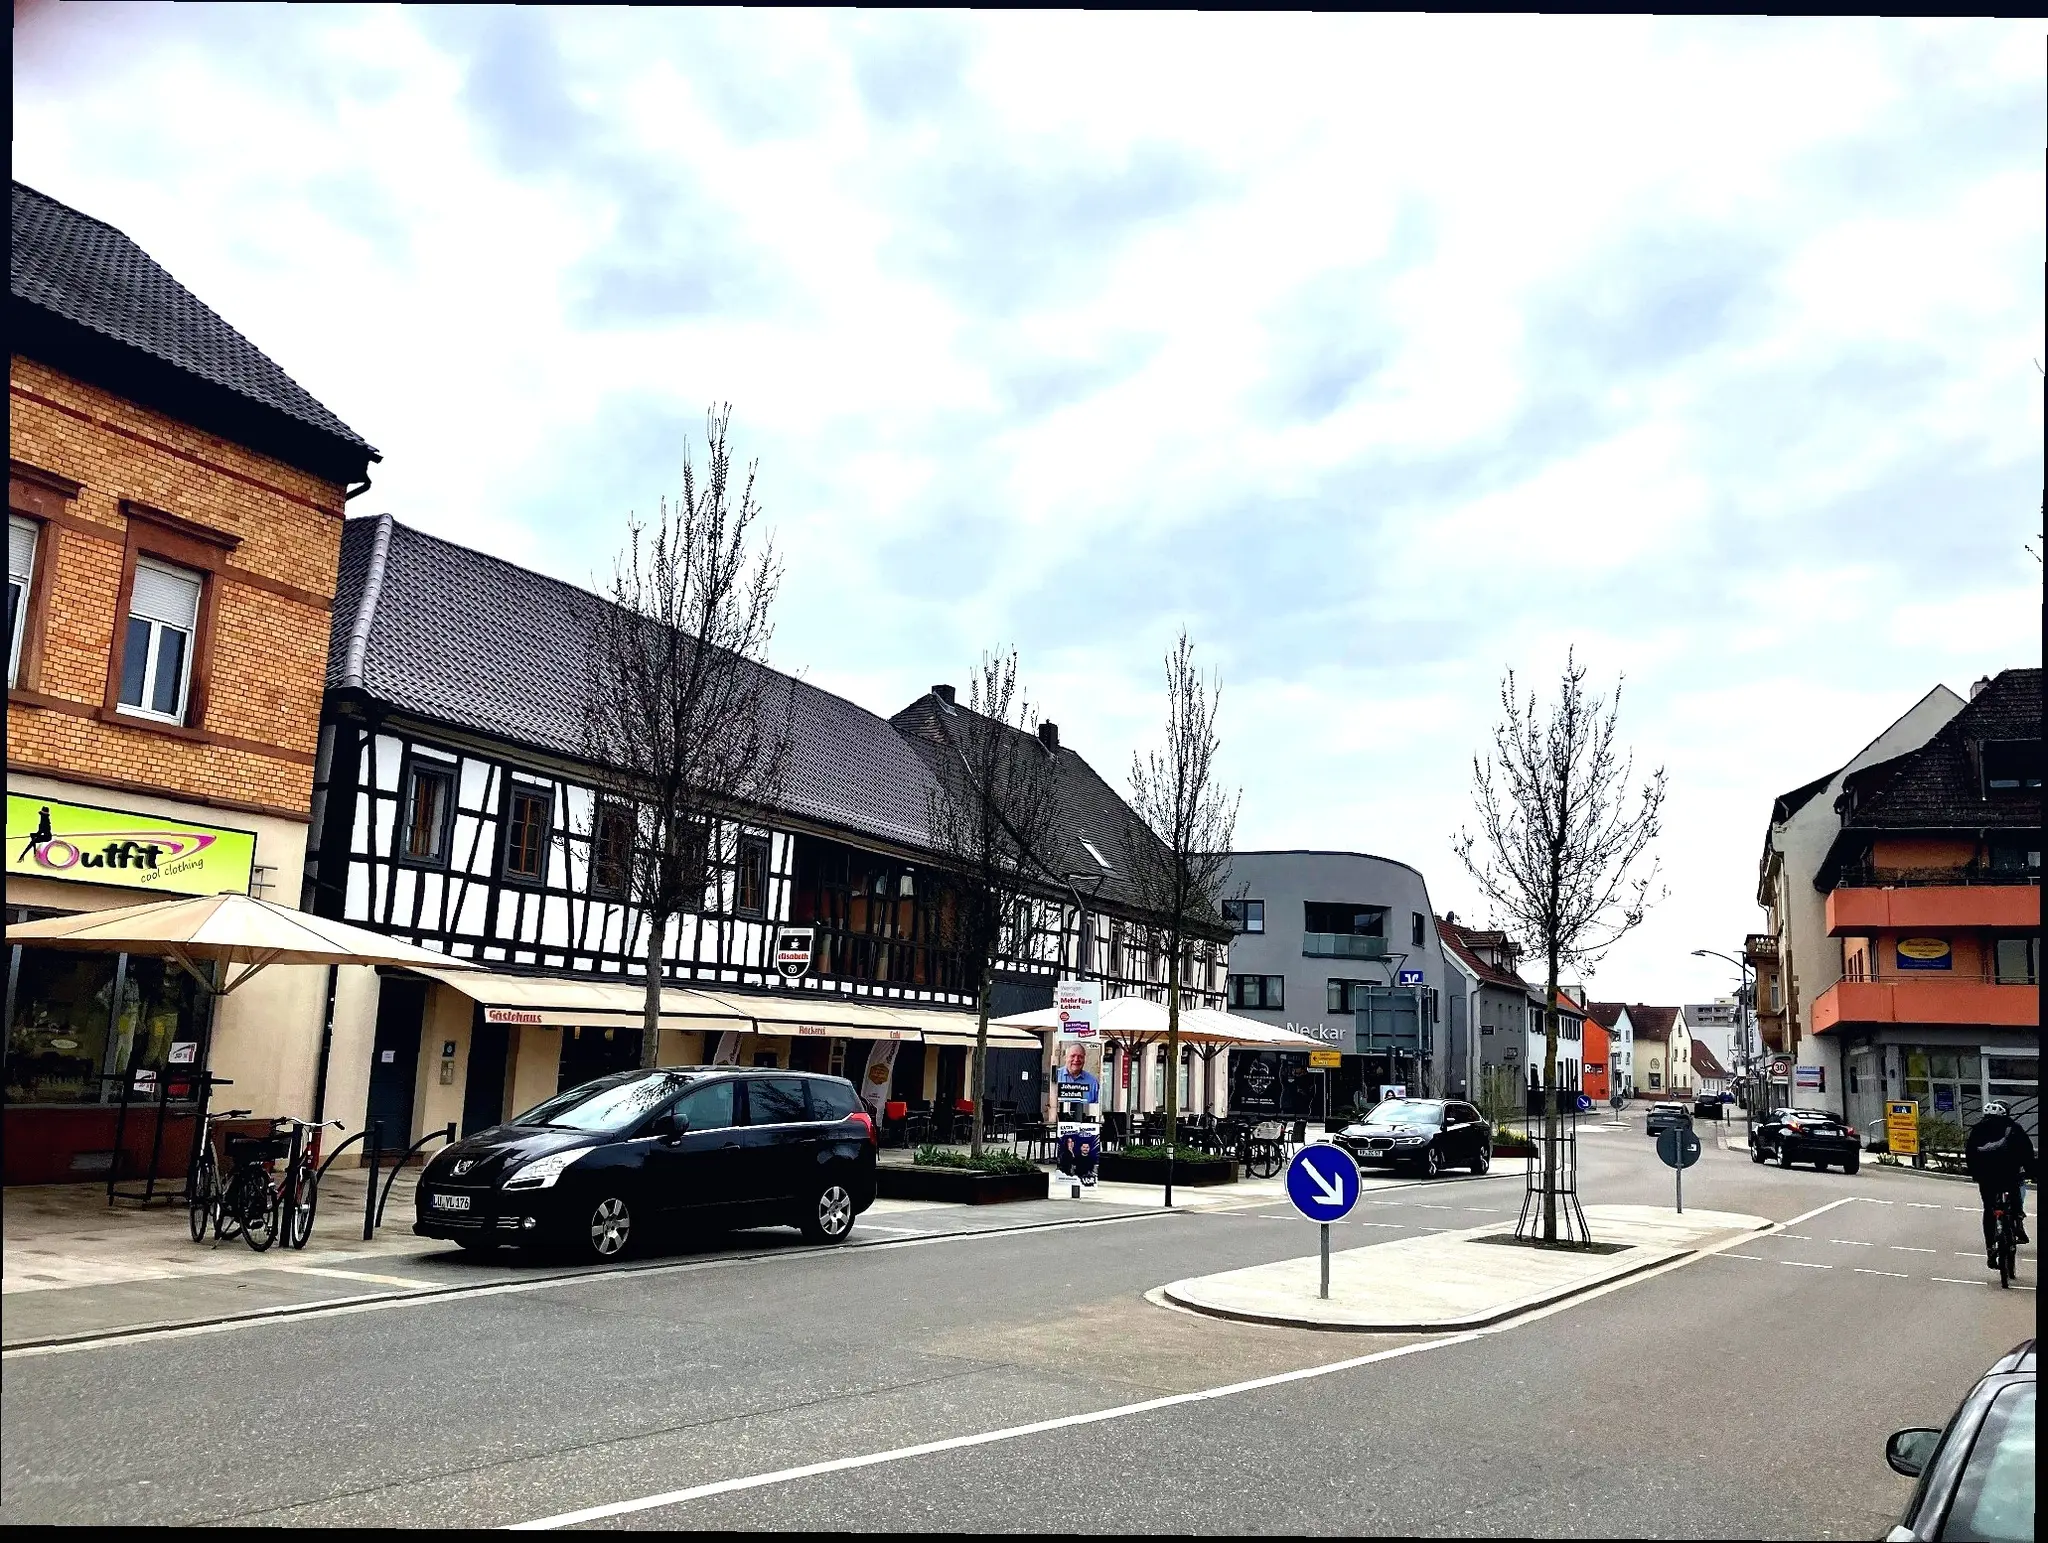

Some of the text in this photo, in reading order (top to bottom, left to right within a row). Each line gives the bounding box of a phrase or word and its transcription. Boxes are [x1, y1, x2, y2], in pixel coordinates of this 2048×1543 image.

[35, 840, 163, 870] Outfit
[140, 857, 204, 884] cool clothing
[488, 1009, 542, 1023] Gästehaus
[1286, 1022, 1347, 1040] Neckar
[1774, 1063, 1785, 1072] 30
[456, 1197, 469, 1209] 176
